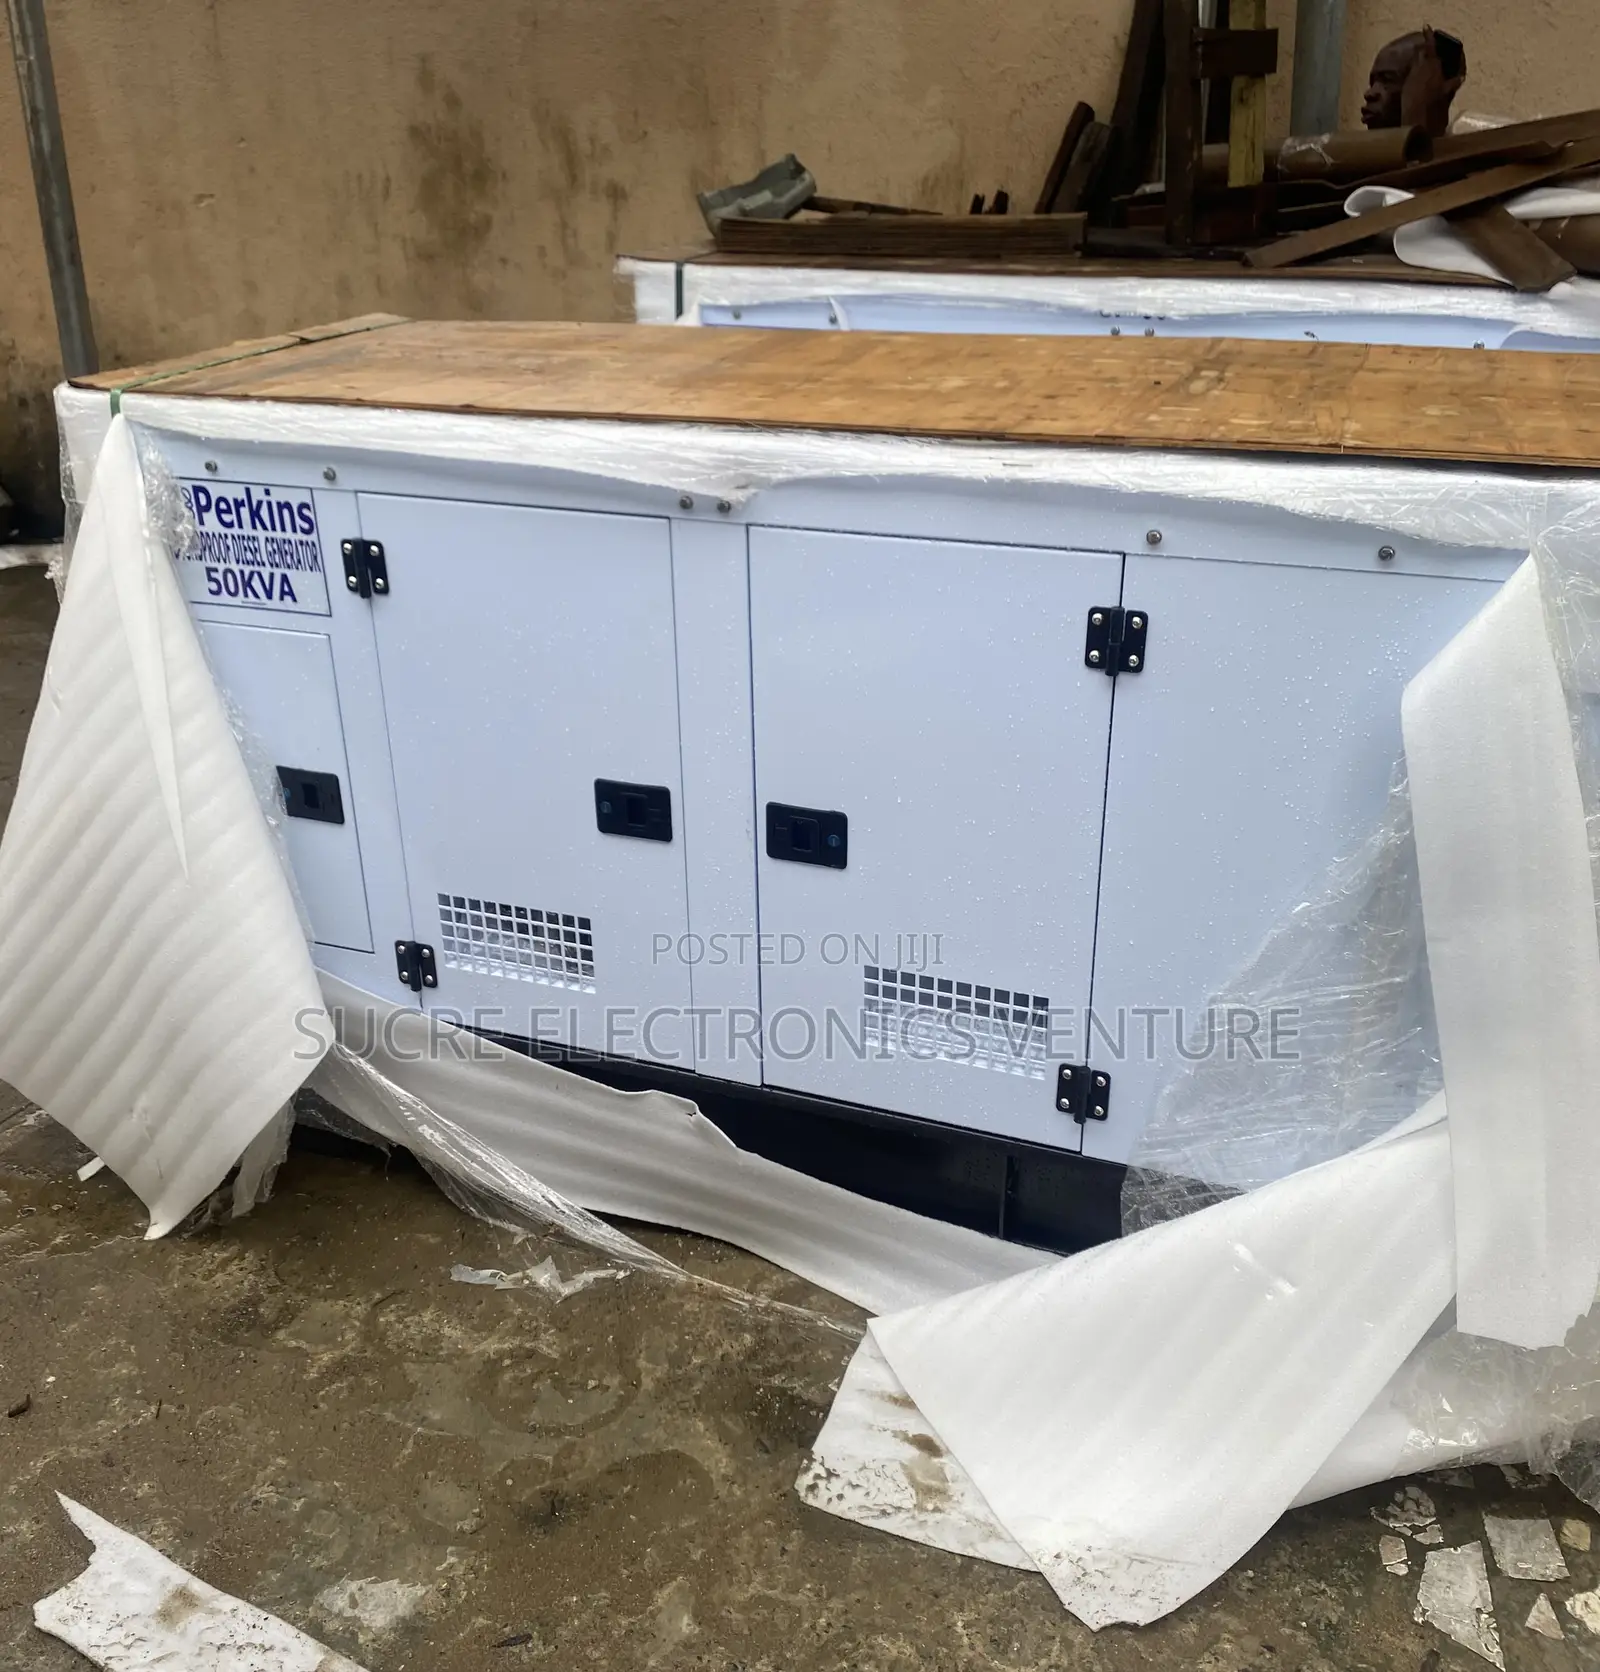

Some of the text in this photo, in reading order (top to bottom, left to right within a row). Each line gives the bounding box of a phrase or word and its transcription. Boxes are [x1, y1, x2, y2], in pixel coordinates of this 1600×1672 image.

[192, 485, 314, 535] Perkins
[231, 533, 266, 567] DIESEL
[265, 536, 321, 572] GENERATOR
[205, 566, 298, 603] 50KVA
